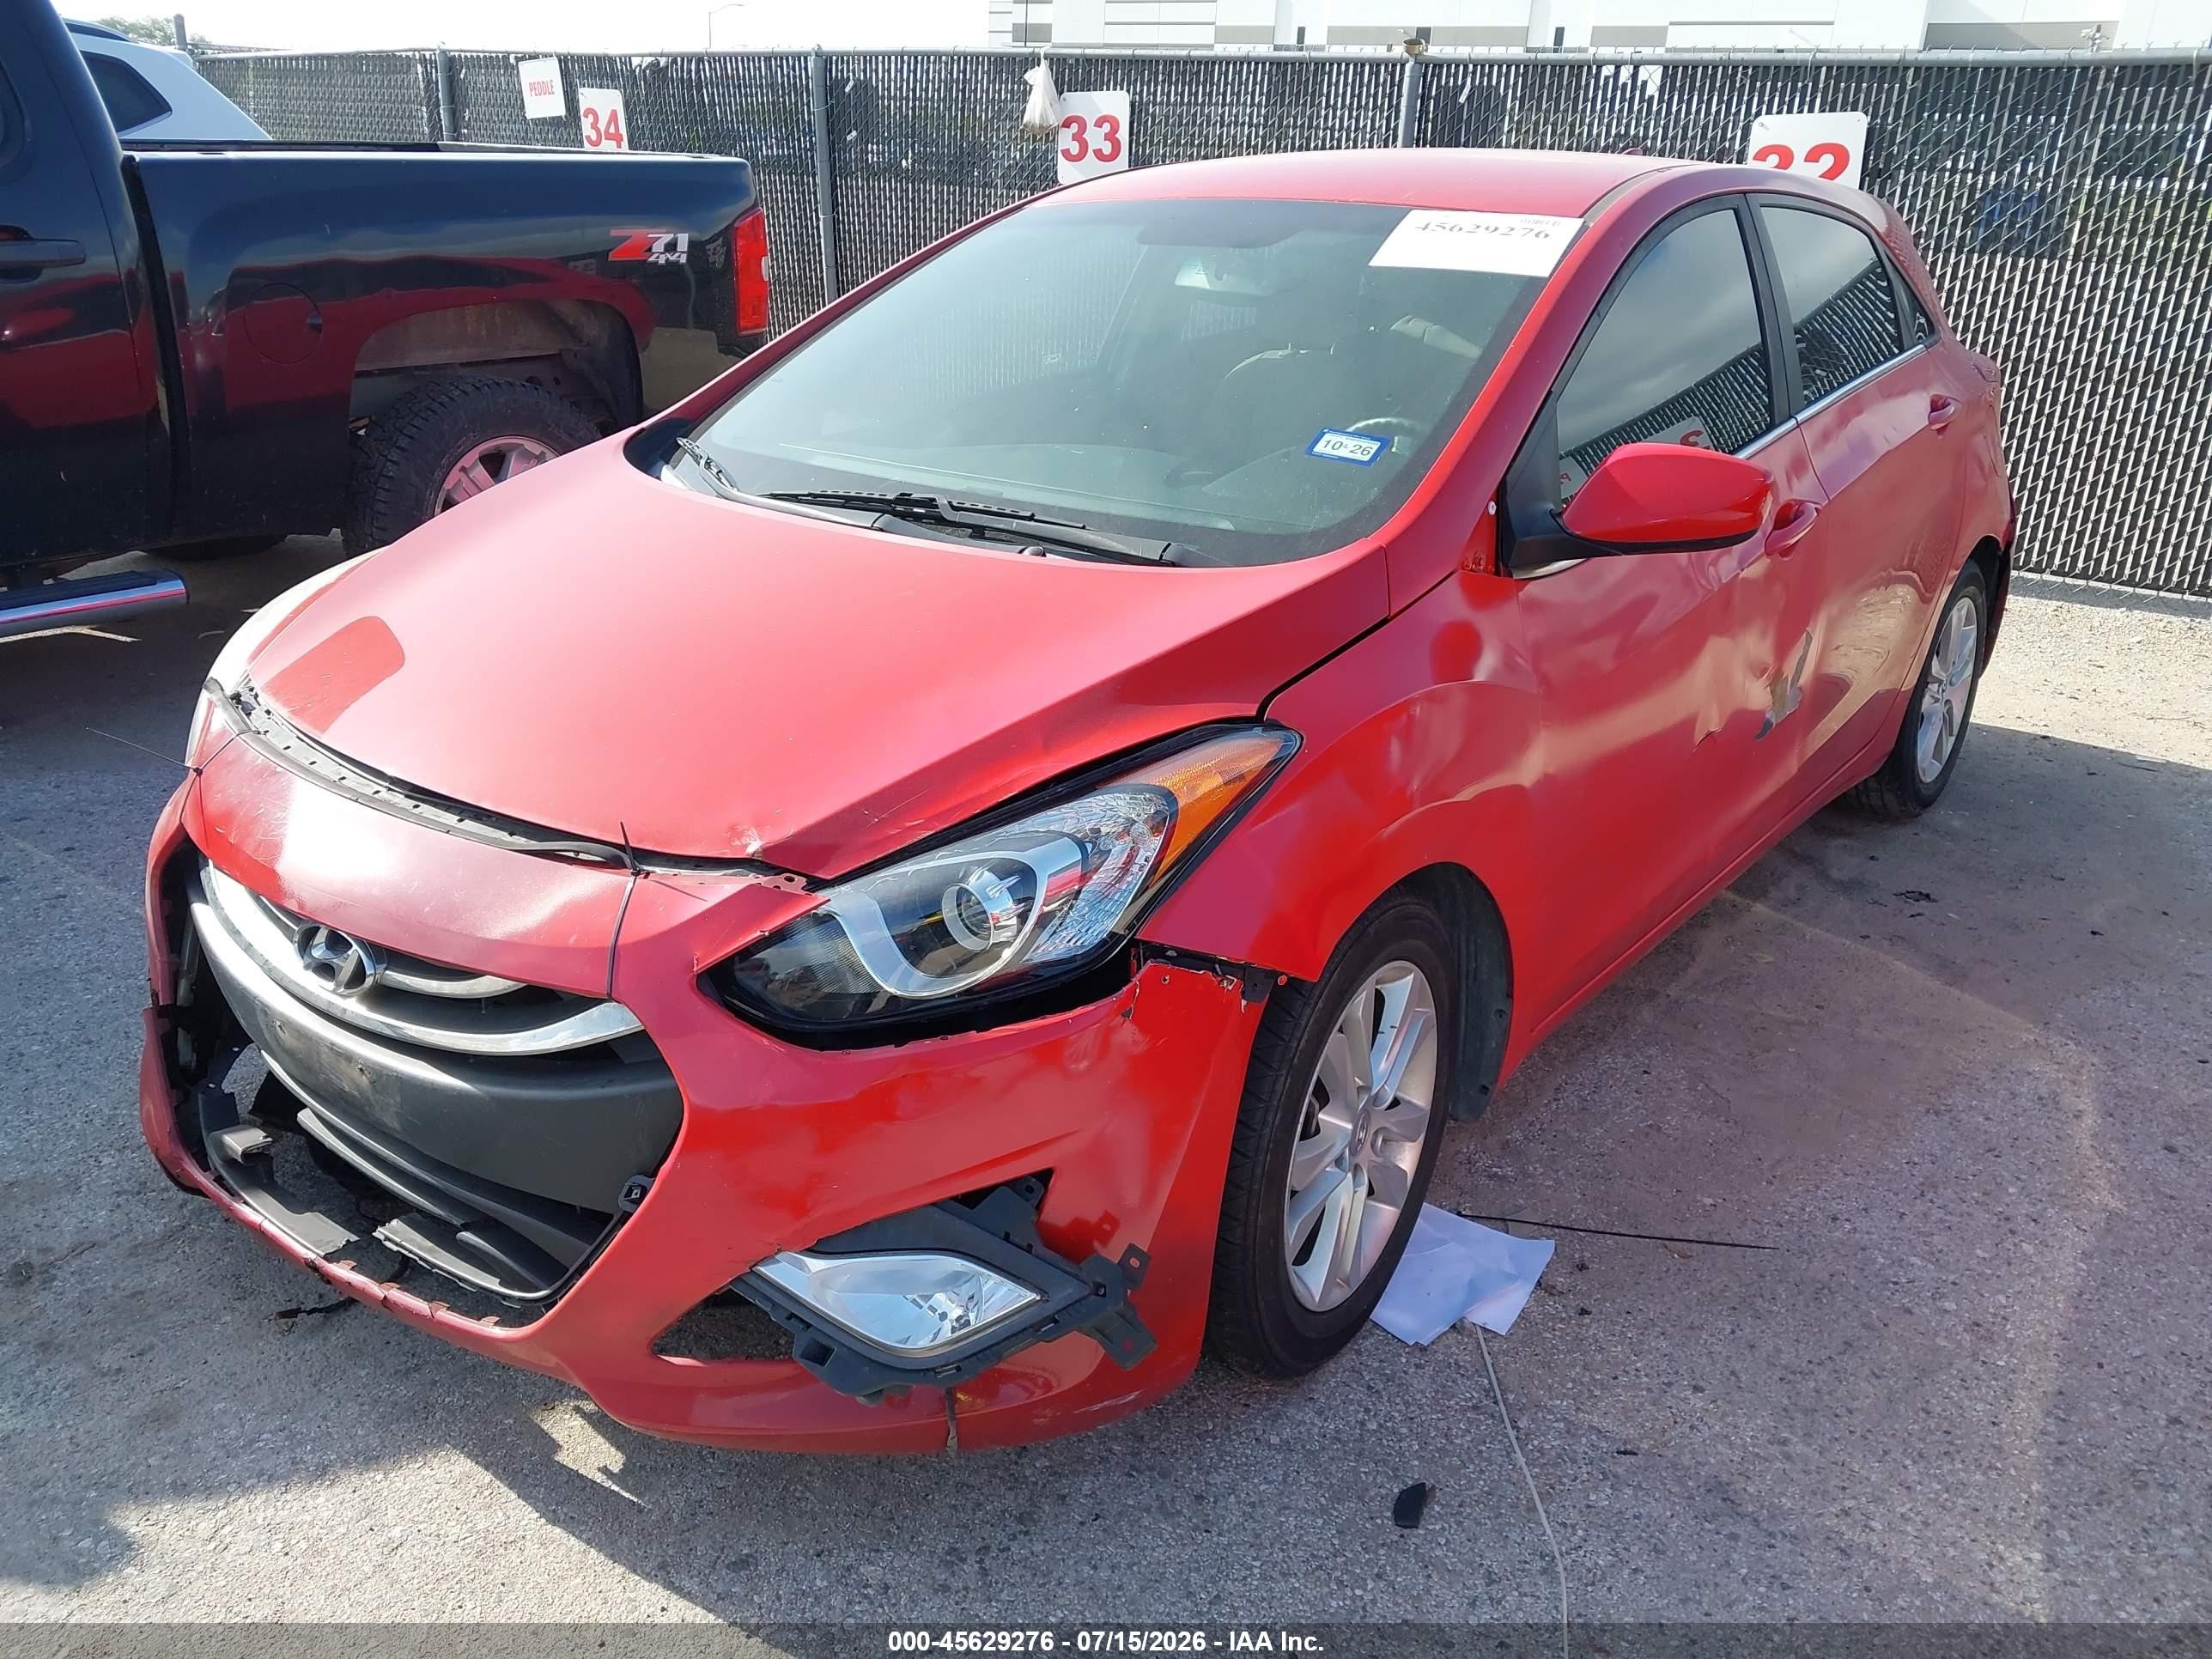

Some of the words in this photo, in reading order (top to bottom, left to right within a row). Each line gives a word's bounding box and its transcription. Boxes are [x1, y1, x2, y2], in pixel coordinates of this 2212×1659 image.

[528, 79, 556, 97] PEDDLE
[582, 107, 623, 149] 34
[1060, 114, 1122, 163] 33
[608, 228, 689, 261] Z71
[1414, 221, 1551, 240] 45629276
